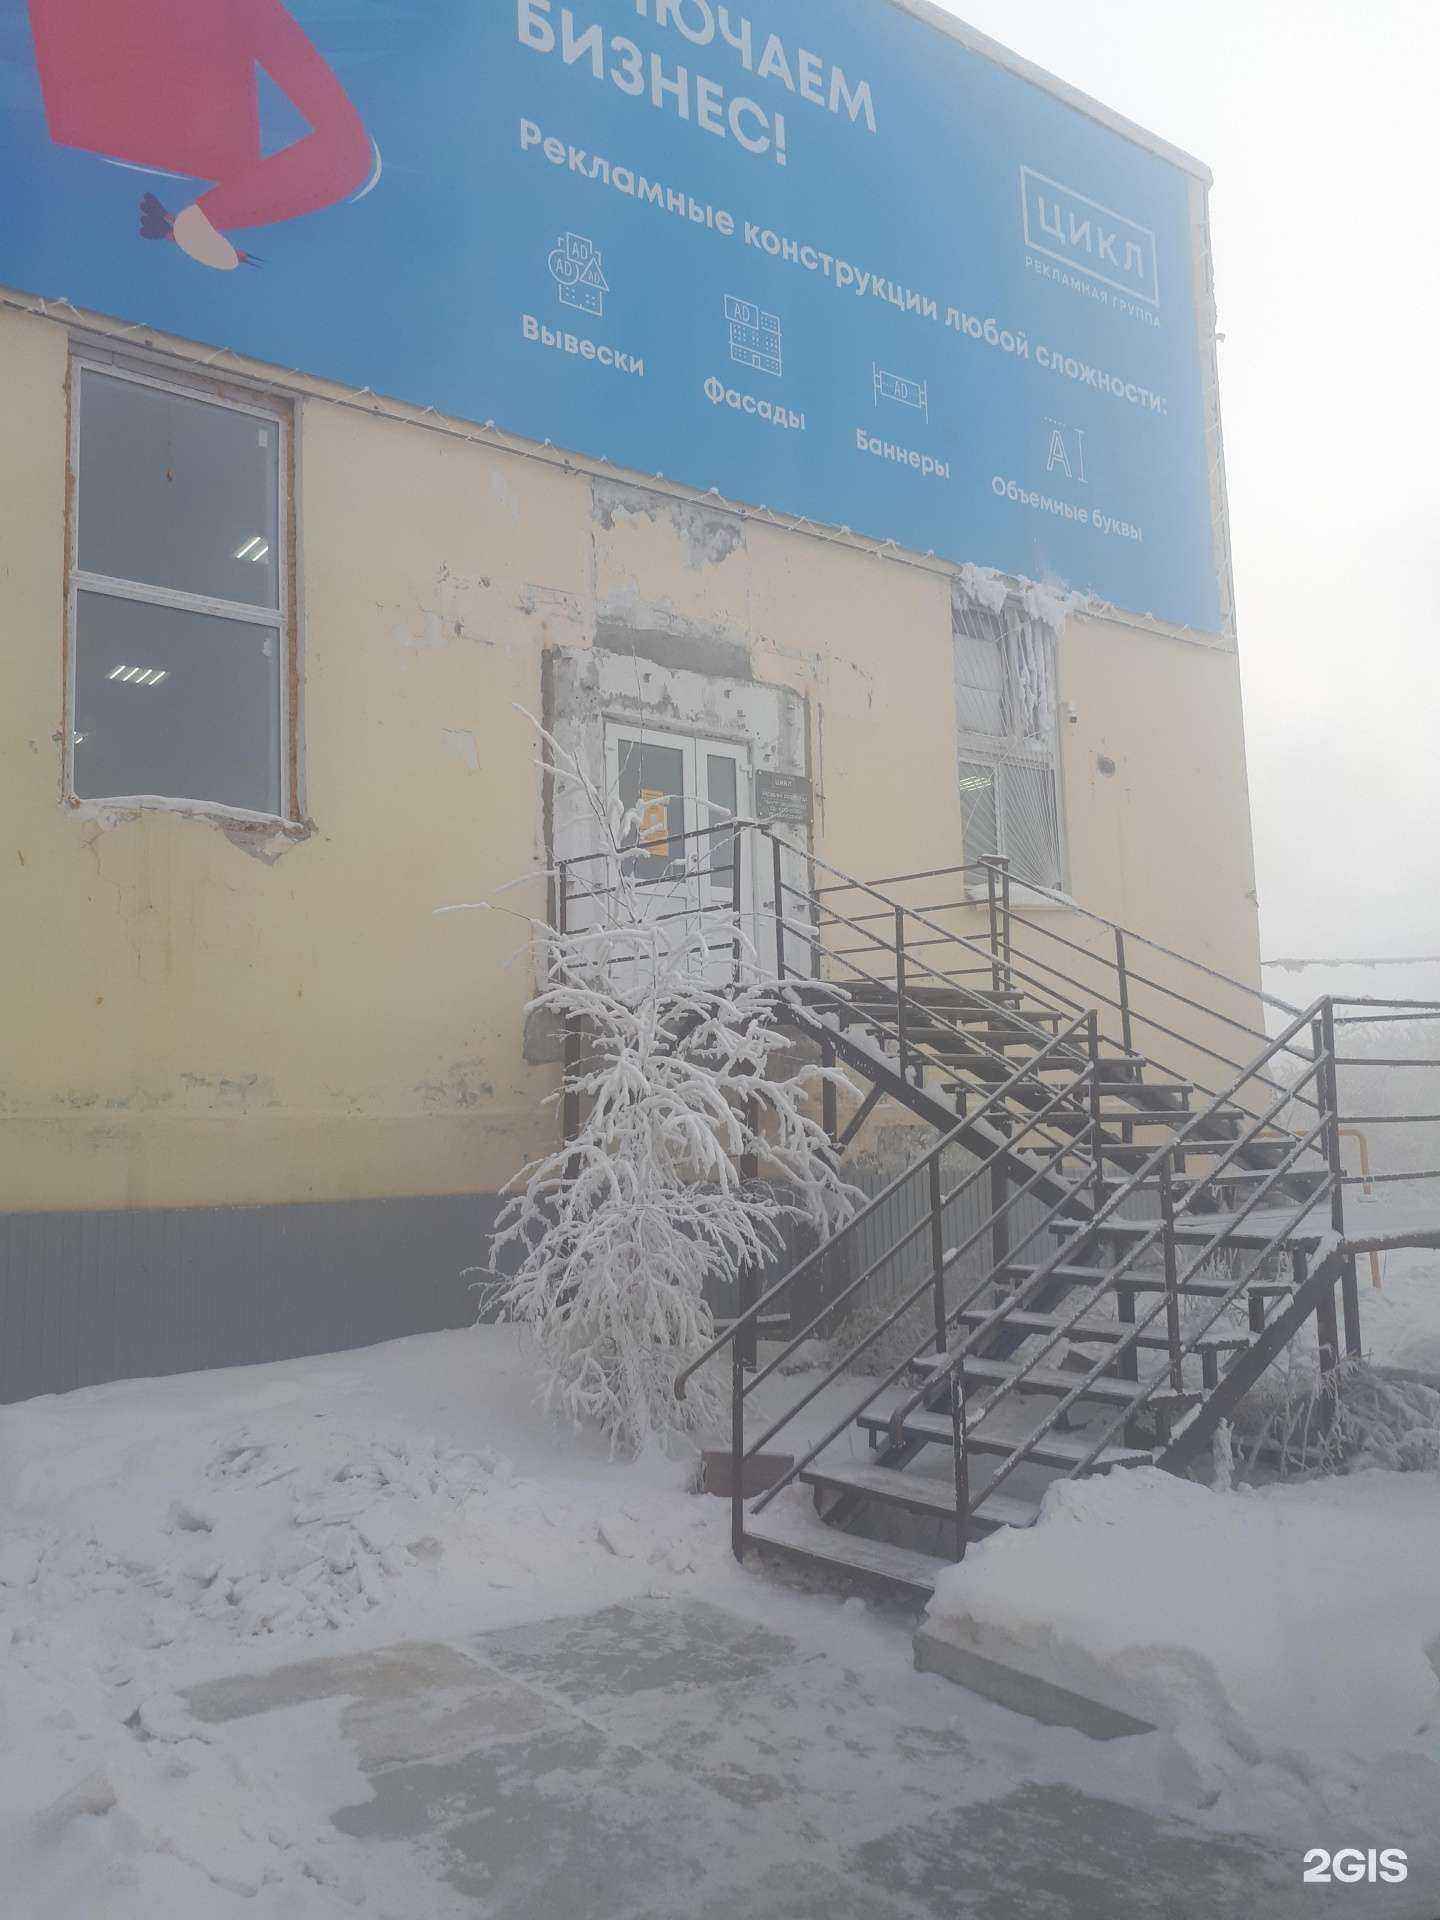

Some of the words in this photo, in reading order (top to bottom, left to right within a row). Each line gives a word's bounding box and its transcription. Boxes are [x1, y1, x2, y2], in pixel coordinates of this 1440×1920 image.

[517, 0, 787, 166] БИЗНЕС!
[637, 0, 877, 134] ЮЧАЕМ
[519, 118, 735, 236] Рекламные
[744, 221, 938, 320] конструкции
[944, 305, 1030, 360] любой
[1035, 345, 1168, 415] сложности:
[555, 258, 572, 276] AD
[572, 241, 588, 260] AD
[1038, 195, 1144, 278] ЦИКЛ
[734, 303, 750, 321] AD
[1025, 255, 1108, 304] РЕКЛАМНАЯ
[1112, 296, 1159, 328] ГРУППА
[521, 314, 644, 376] Вывески
[703, 376, 806, 430] Фасады
[894, 380, 908, 400] AD
[856, 428, 950, 480] Баннеры
[991, 475, 1088, 523] Объемные
[1092, 508, 1144, 543] буквы
